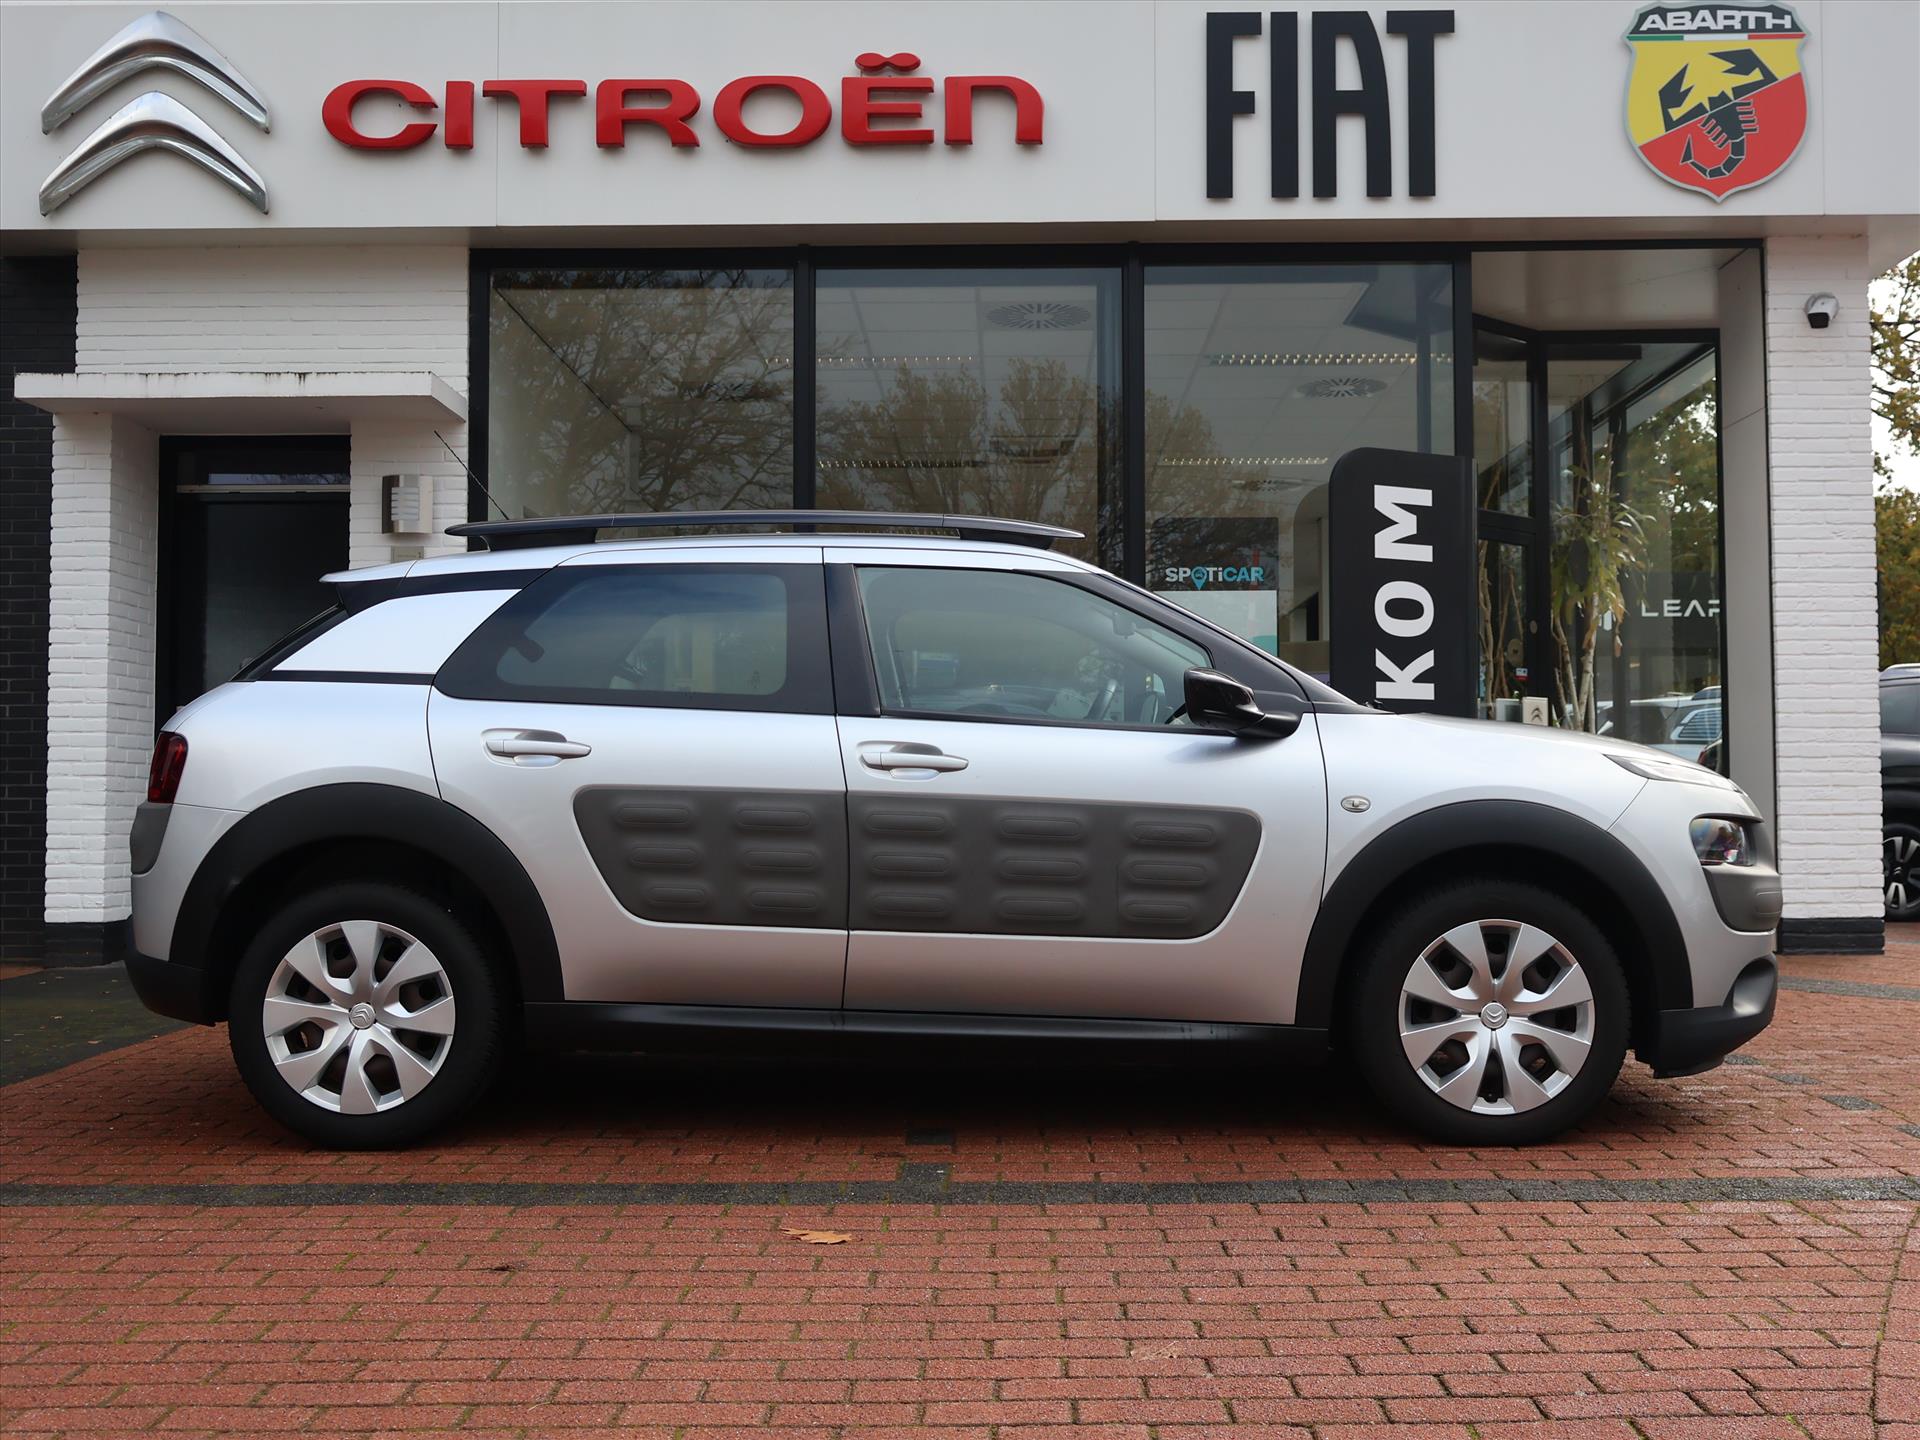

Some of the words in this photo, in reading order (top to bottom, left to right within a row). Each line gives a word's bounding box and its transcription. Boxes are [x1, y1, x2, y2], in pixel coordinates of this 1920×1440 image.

[1639, 9, 1792, 31] ABARTH
[321, 52, 1045, 151] CITROËN
[1206, 9, 1455, 199] FIAT
[1373, 484, 1435, 700] KOM
